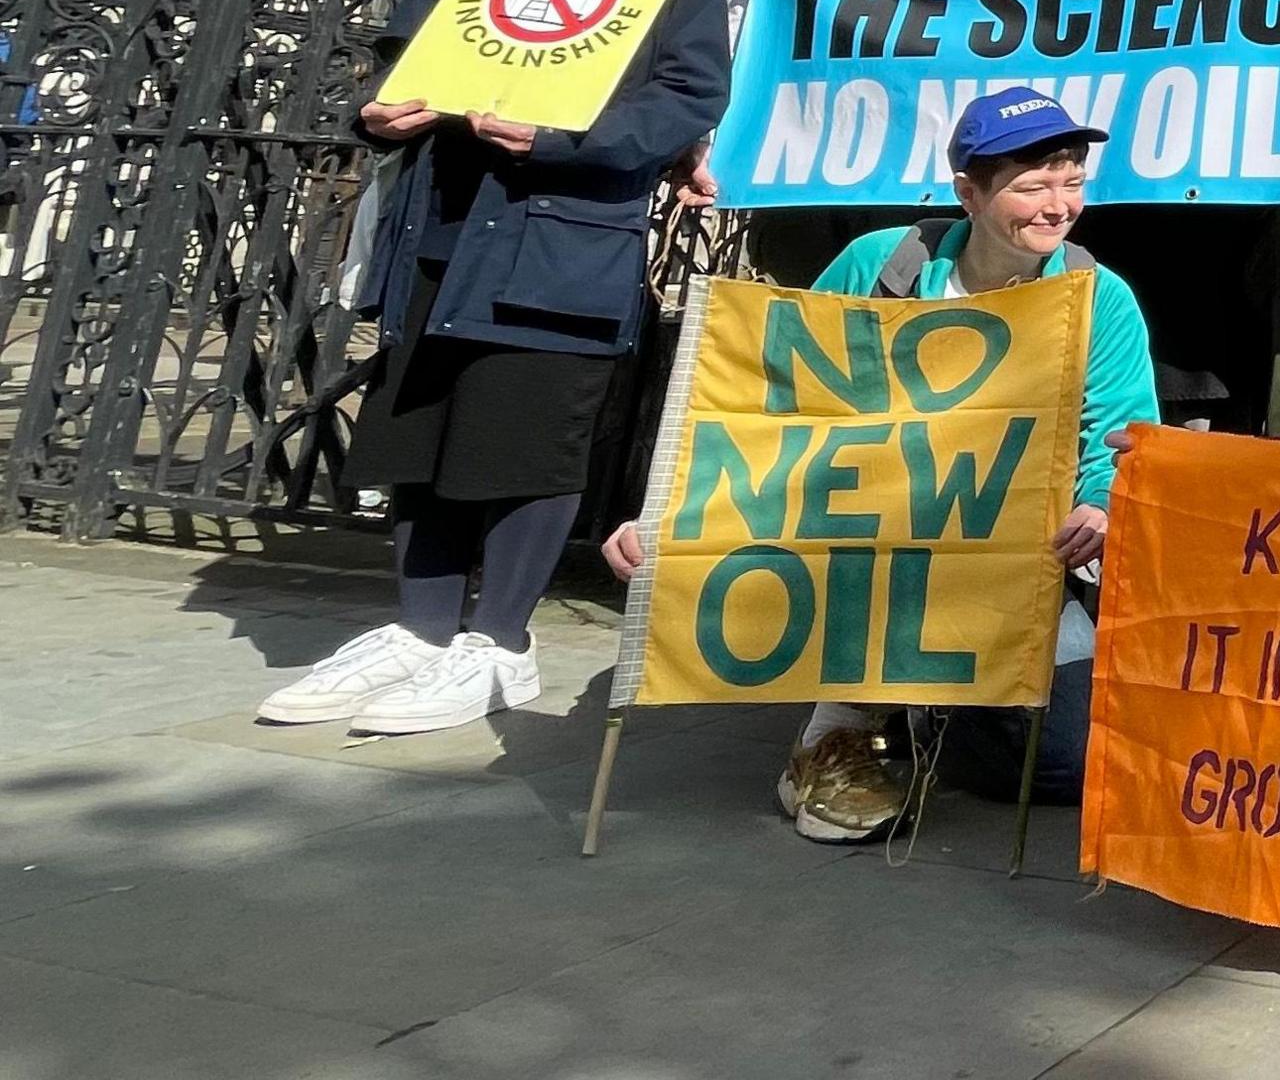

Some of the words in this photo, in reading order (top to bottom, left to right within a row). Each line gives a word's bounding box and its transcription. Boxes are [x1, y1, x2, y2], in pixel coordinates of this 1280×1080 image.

[750, 78, 890, 187] NO
[902, 73, 1126, 185] NW
[763, 298, 1012, 416] NO
[672, 416, 1037, 541] NEW
[698, 544, 978, 688] OIL
[1180, 622, 1241, 694] IT
